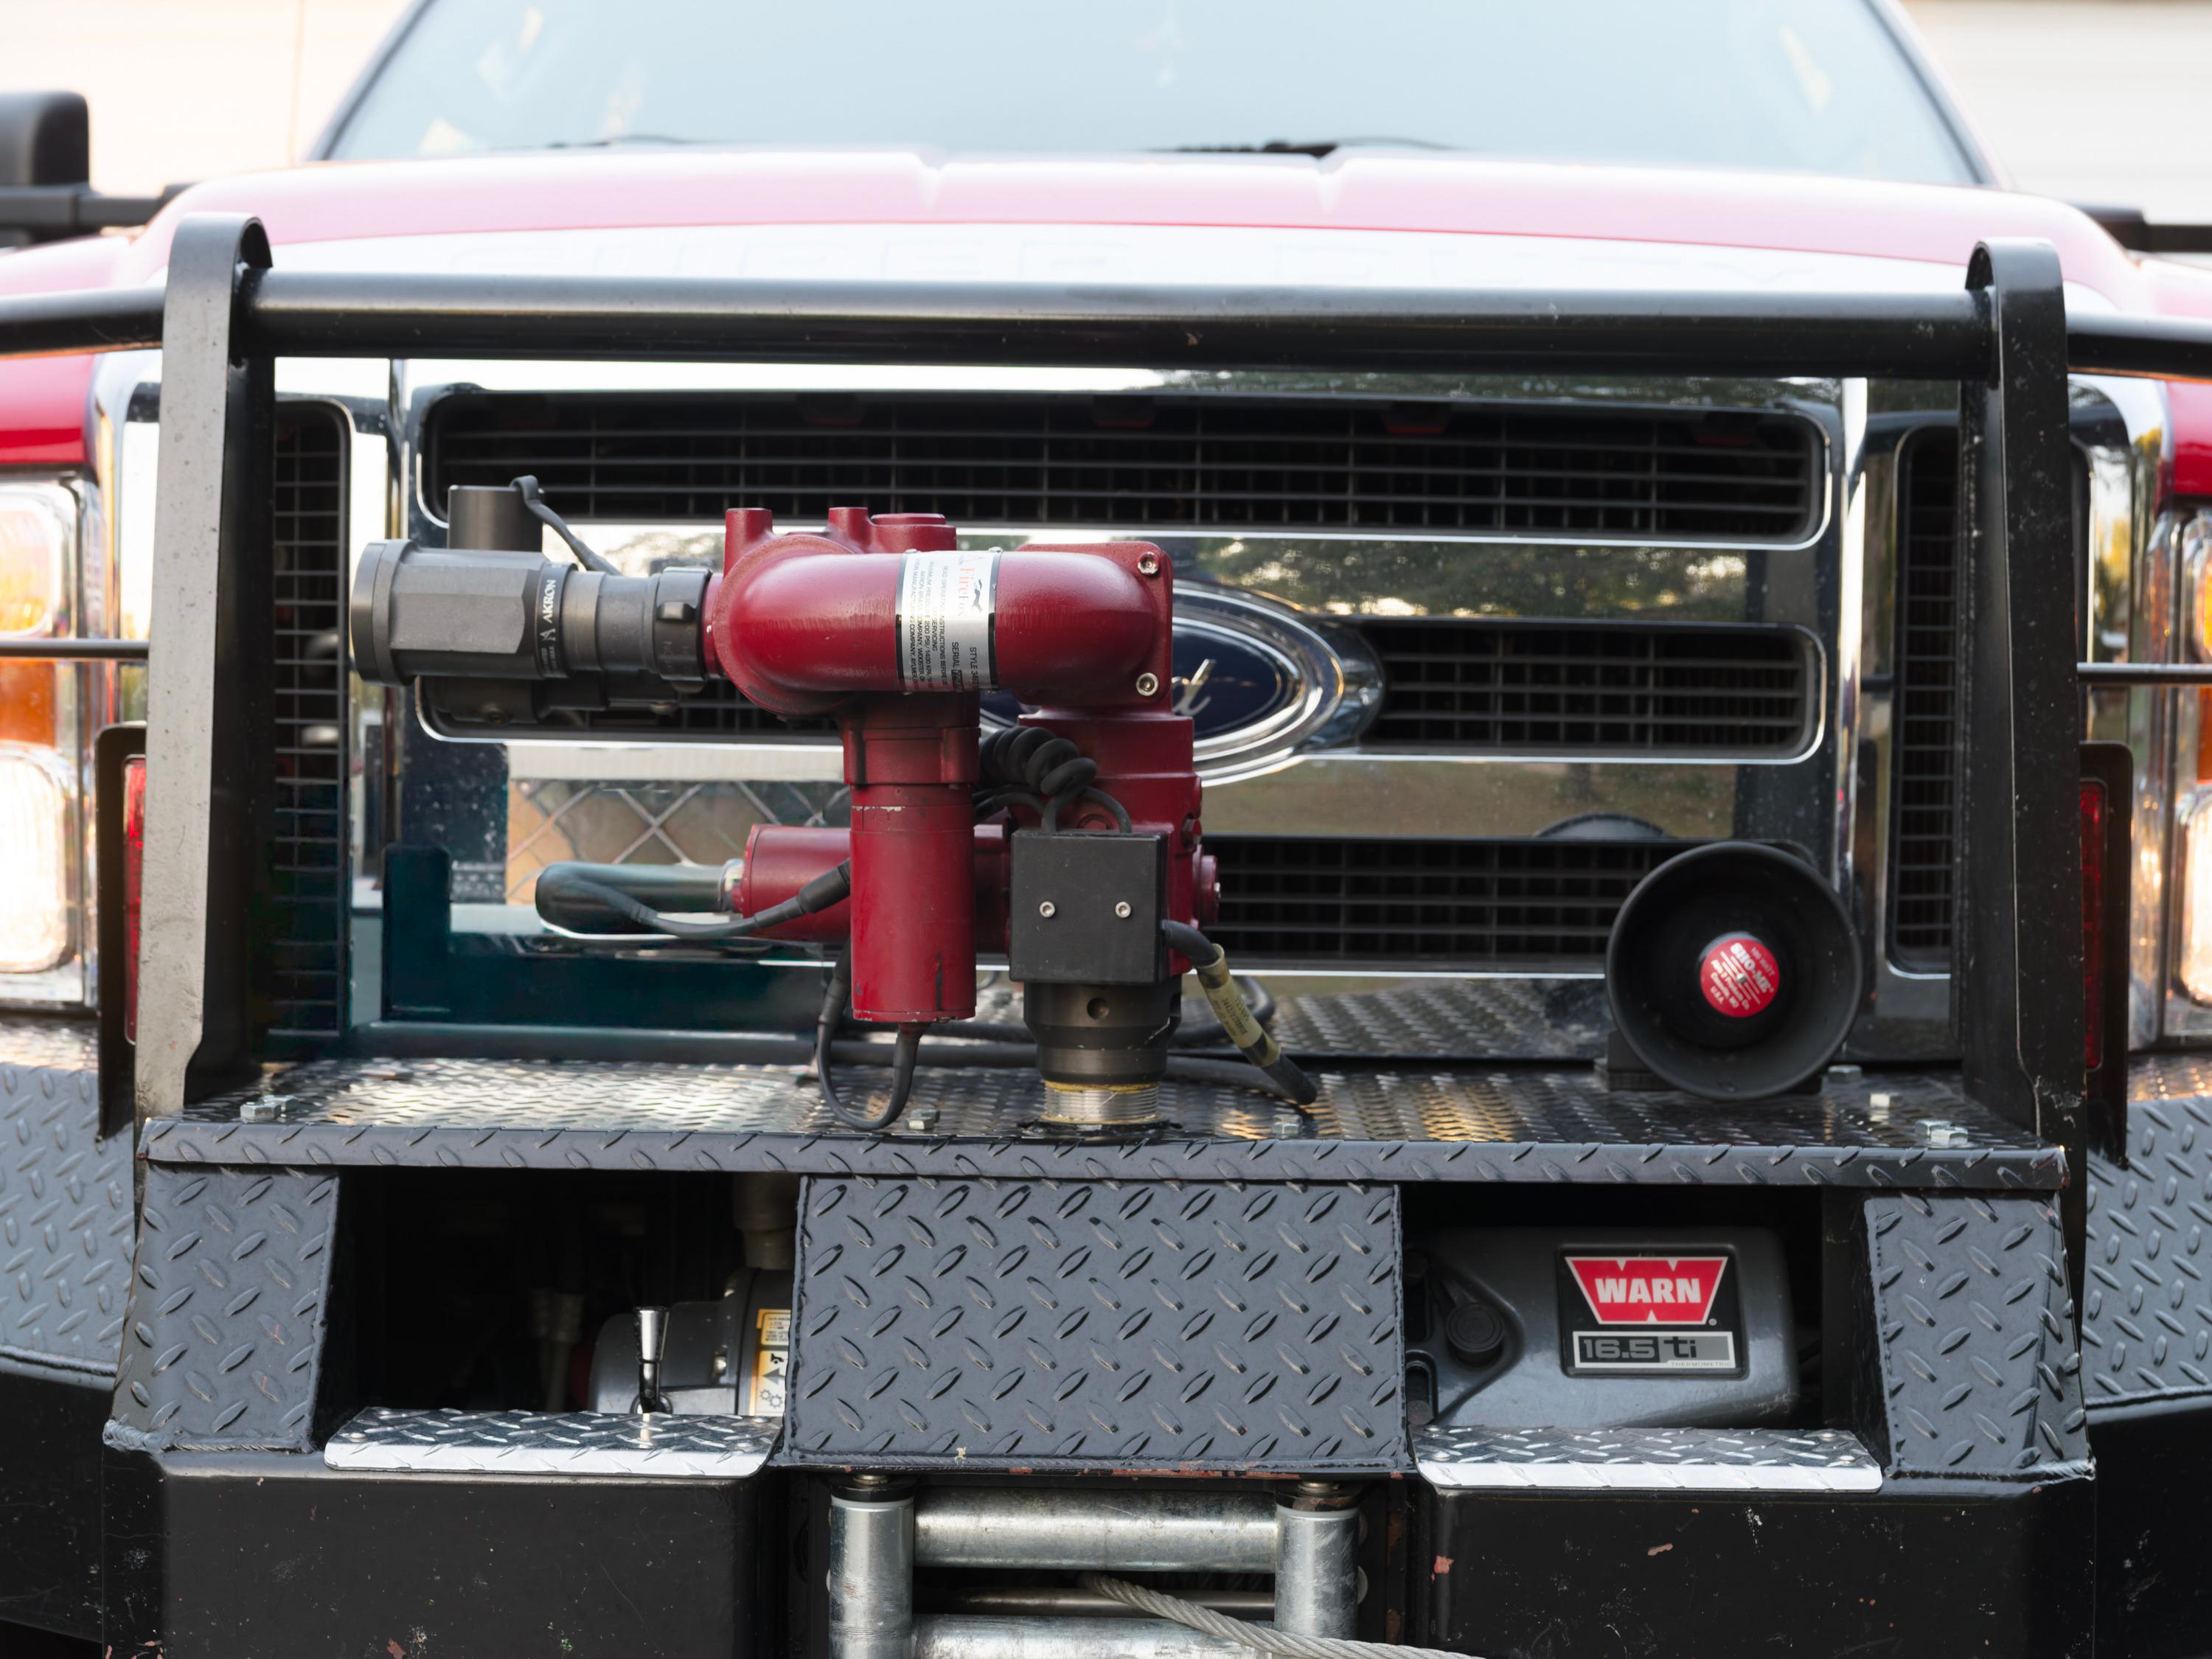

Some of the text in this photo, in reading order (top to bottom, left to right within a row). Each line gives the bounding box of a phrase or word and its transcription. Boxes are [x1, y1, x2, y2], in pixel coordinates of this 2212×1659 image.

[542, 579, 557, 623] AKRON
[969, 647, 977, 669] STYLE
[1595, 1278, 1701, 1304] WARN
[1582, 1336, 1697, 1359] 16.5 ti
